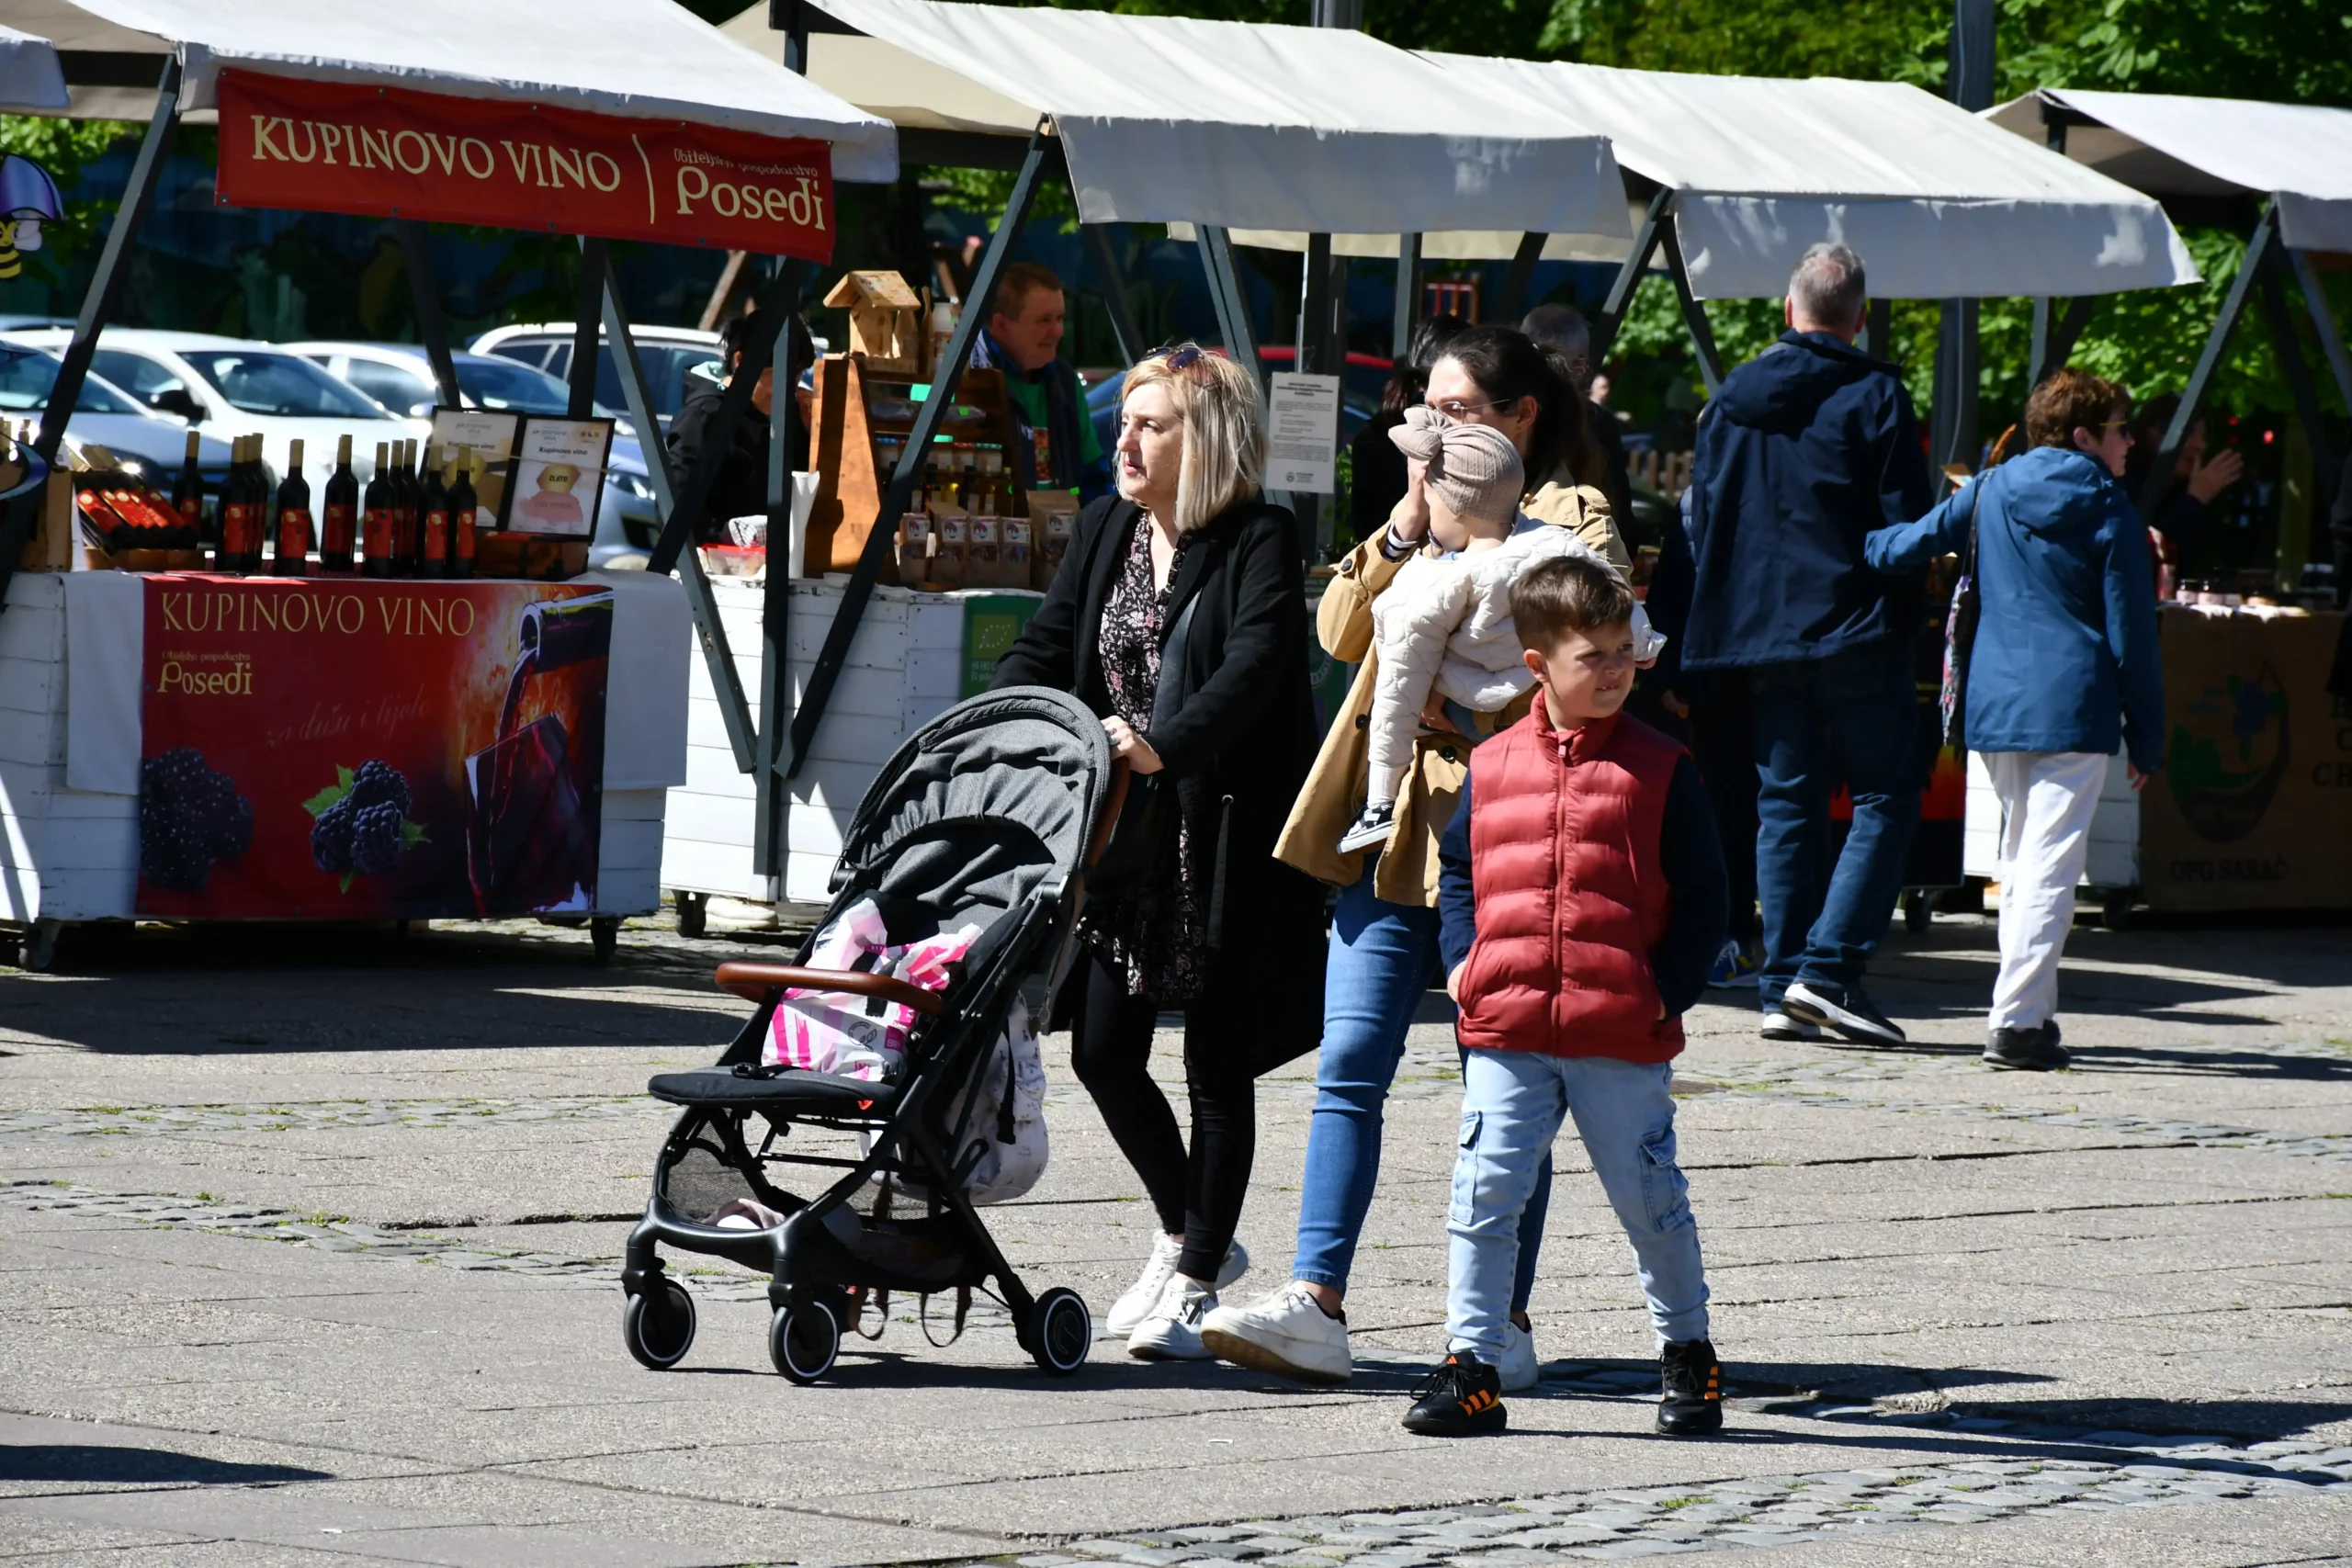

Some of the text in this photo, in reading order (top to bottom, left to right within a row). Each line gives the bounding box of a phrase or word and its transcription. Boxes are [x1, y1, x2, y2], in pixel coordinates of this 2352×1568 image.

[251, 115, 620, 192] KUPINOVO VINO
[538, 446, 571, 455] Kupinovo
[161, 592, 475, 637] KUPINOVO VINO
